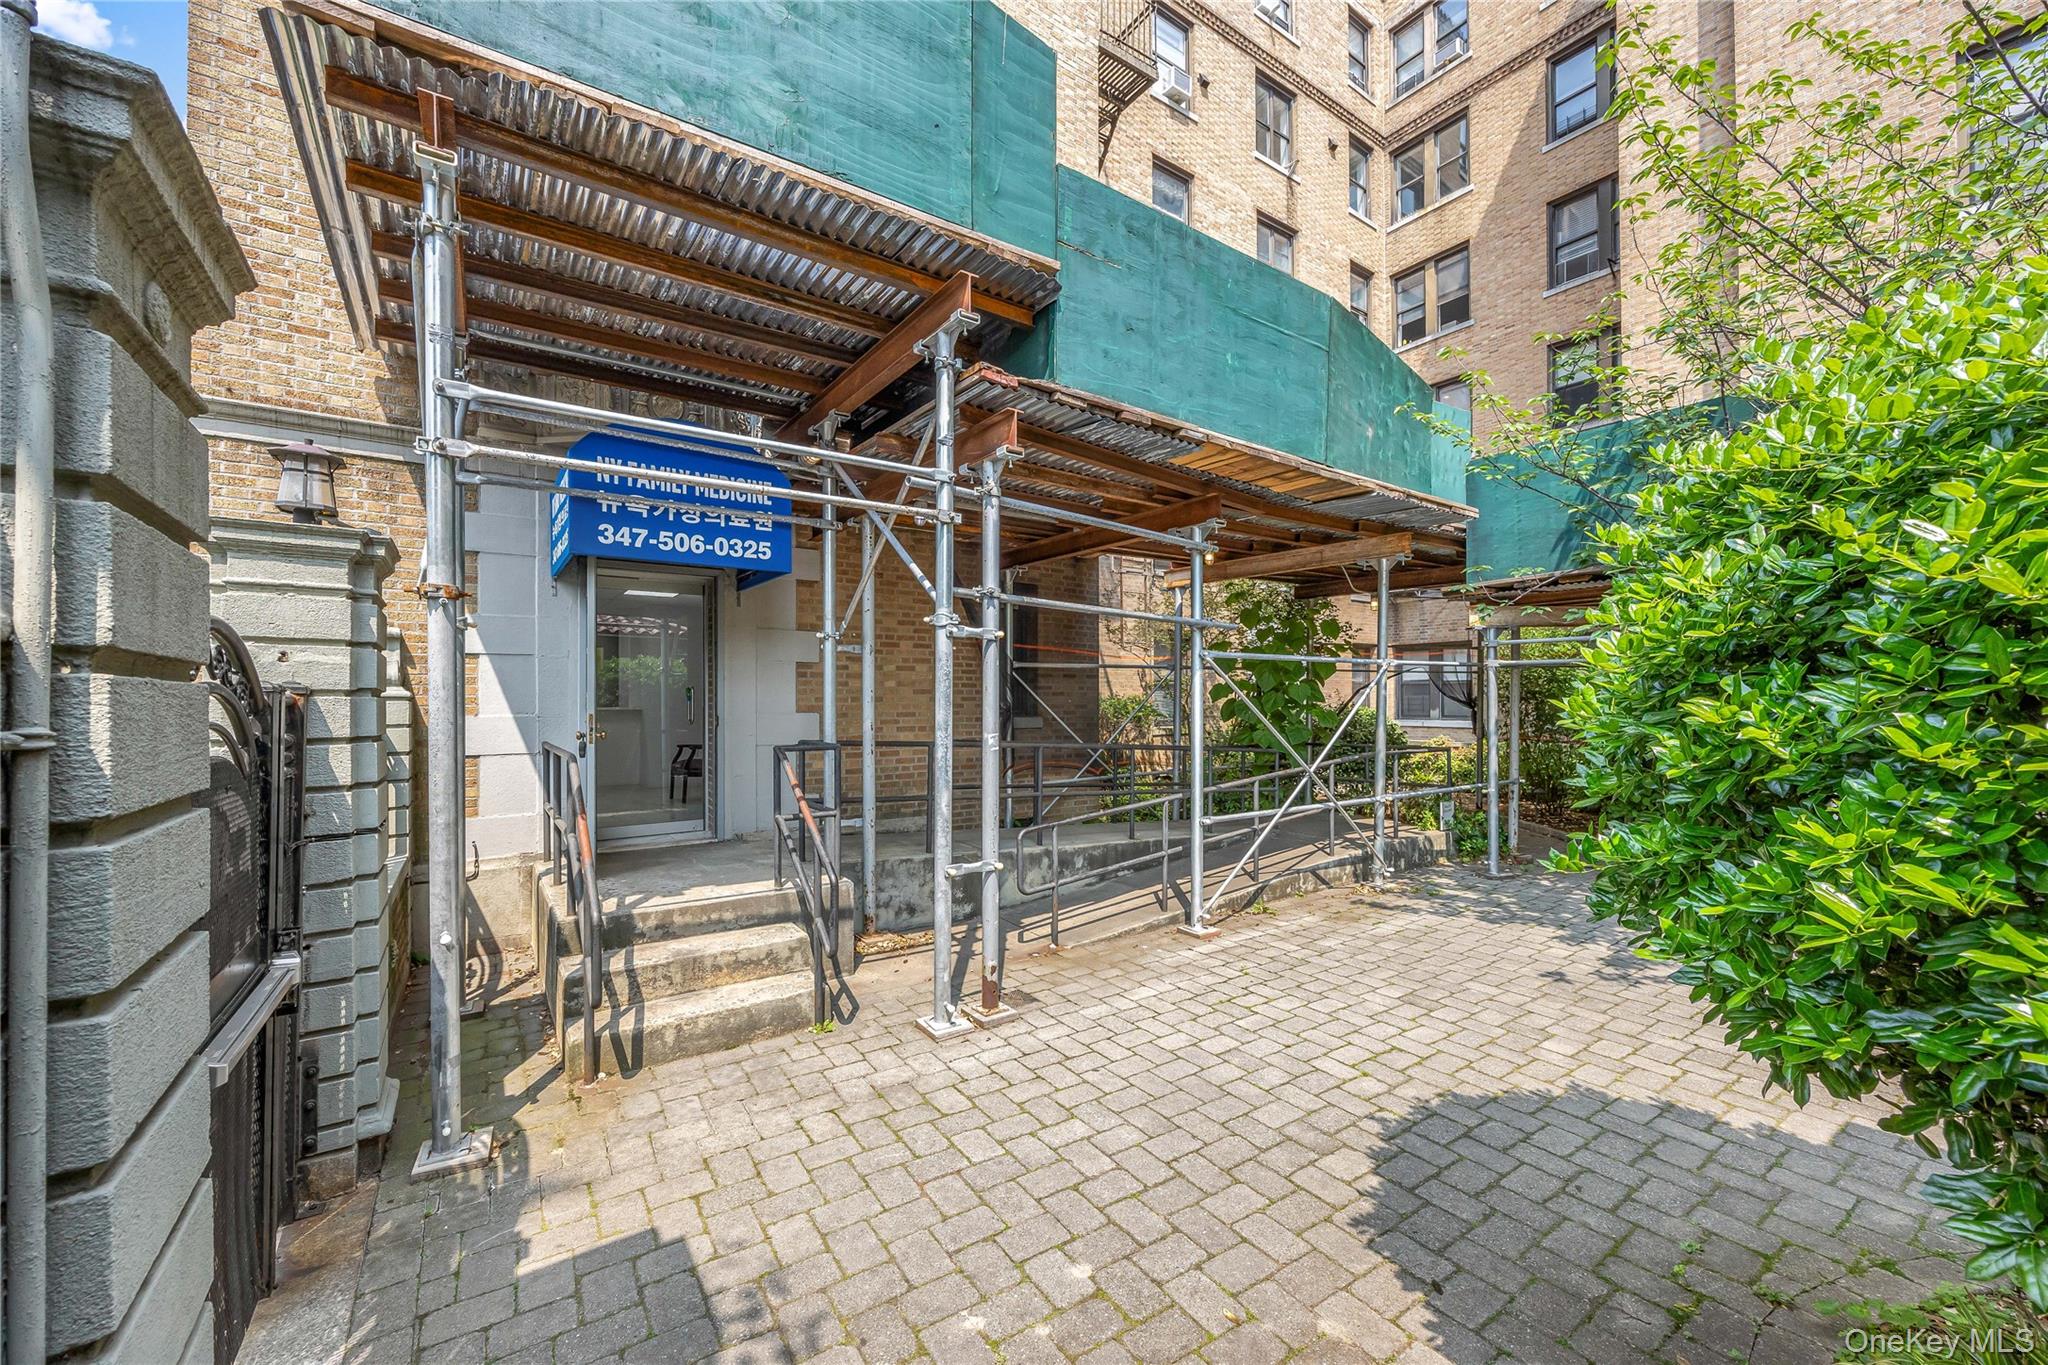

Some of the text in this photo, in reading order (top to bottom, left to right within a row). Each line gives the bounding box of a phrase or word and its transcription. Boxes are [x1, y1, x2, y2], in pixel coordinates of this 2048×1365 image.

[597, 455, 773, 506] NY FAMILY MEDICINE
[597, 523, 772, 560] 347-506-0325
